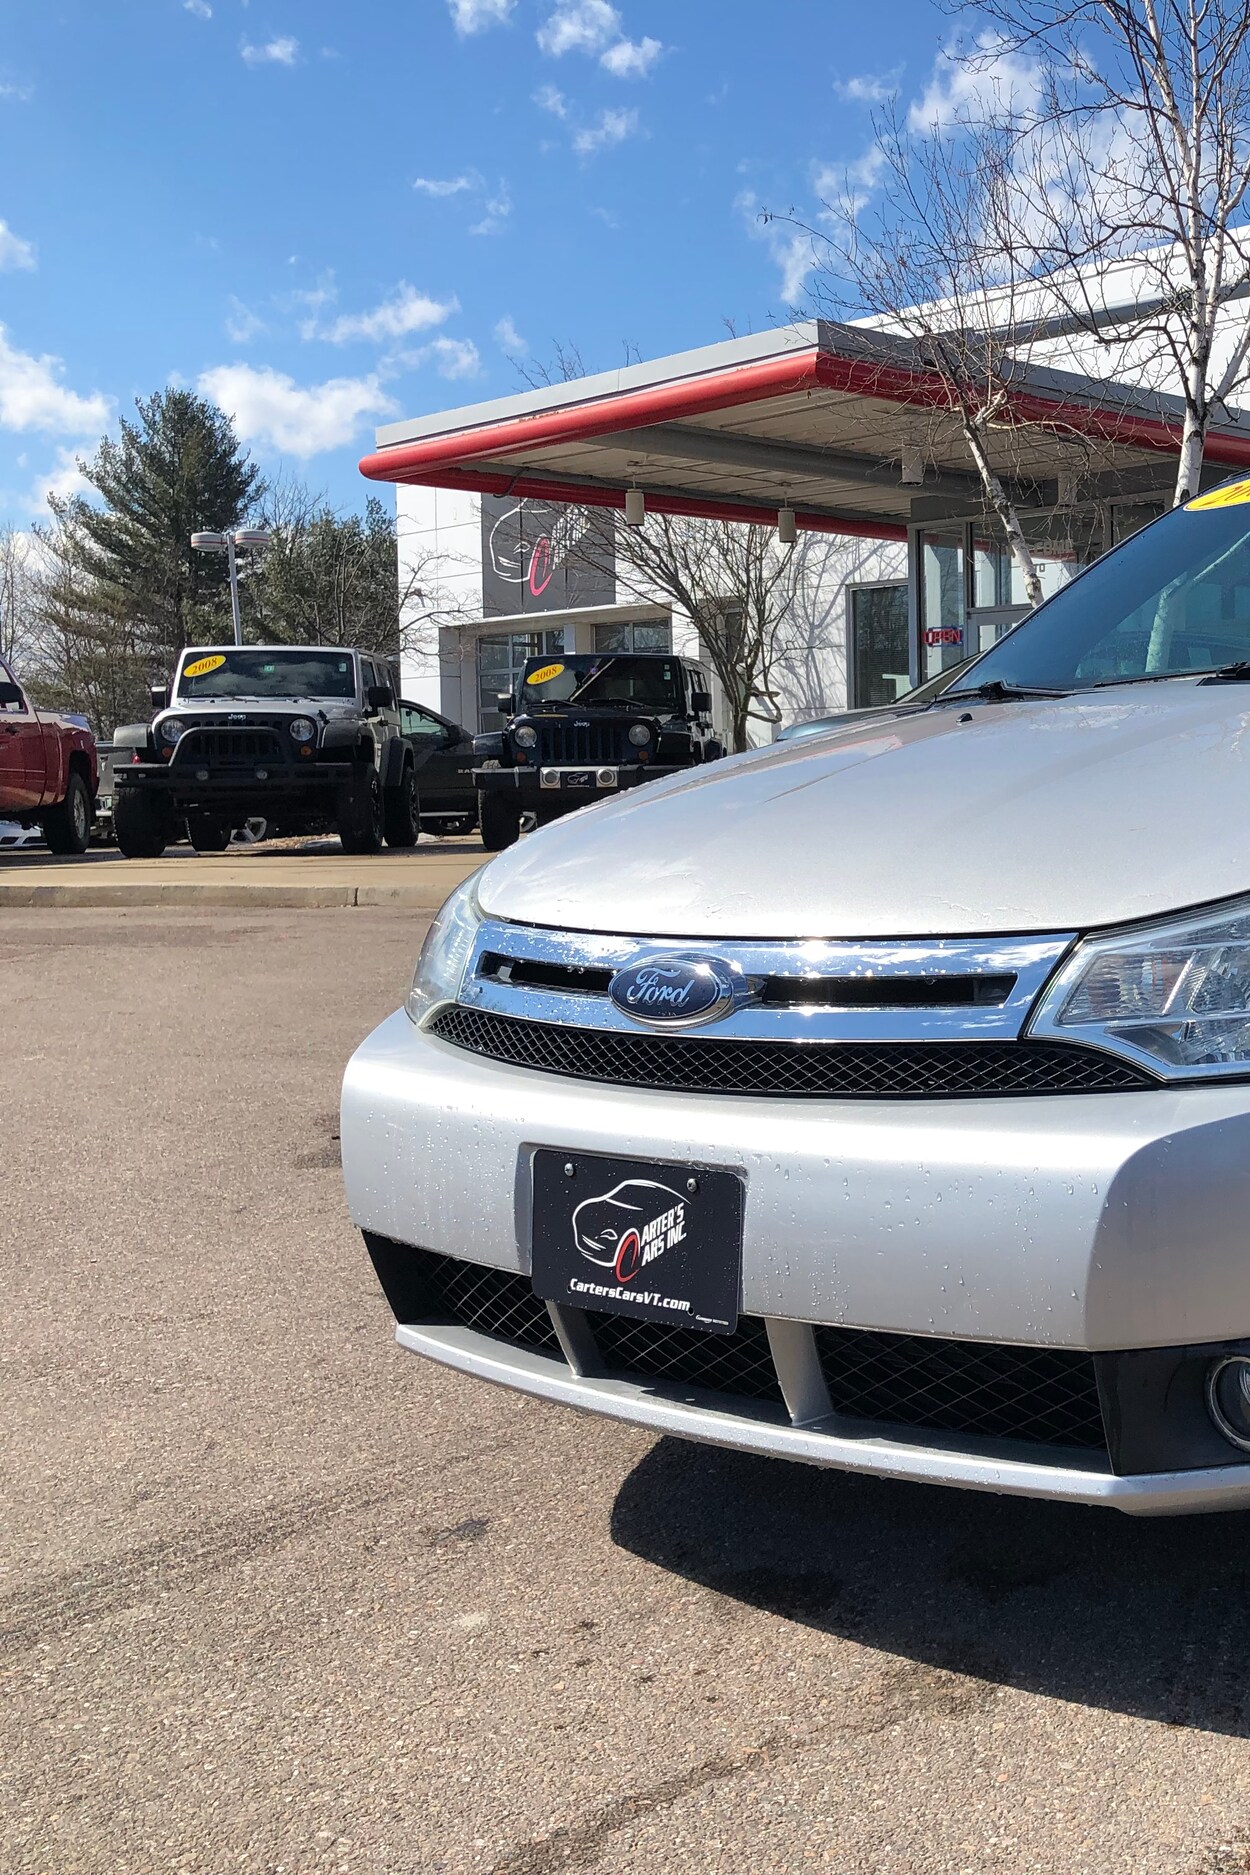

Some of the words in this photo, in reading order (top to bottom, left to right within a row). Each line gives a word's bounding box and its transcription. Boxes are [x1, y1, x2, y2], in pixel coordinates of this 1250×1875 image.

[923, 628, 961, 644] OPEN
[191, 657, 218, 675] 2008
[535, 666, 557, 682] 2008
[227, 713, 247, 721] Jeep
[573, 720, 590, 728] Jeep
[626, 967, 695, 1007] Ford
[667, 1220, 687, 1249] INC.
[569, 1278, 691, 1312] CartersCarsVT.com
